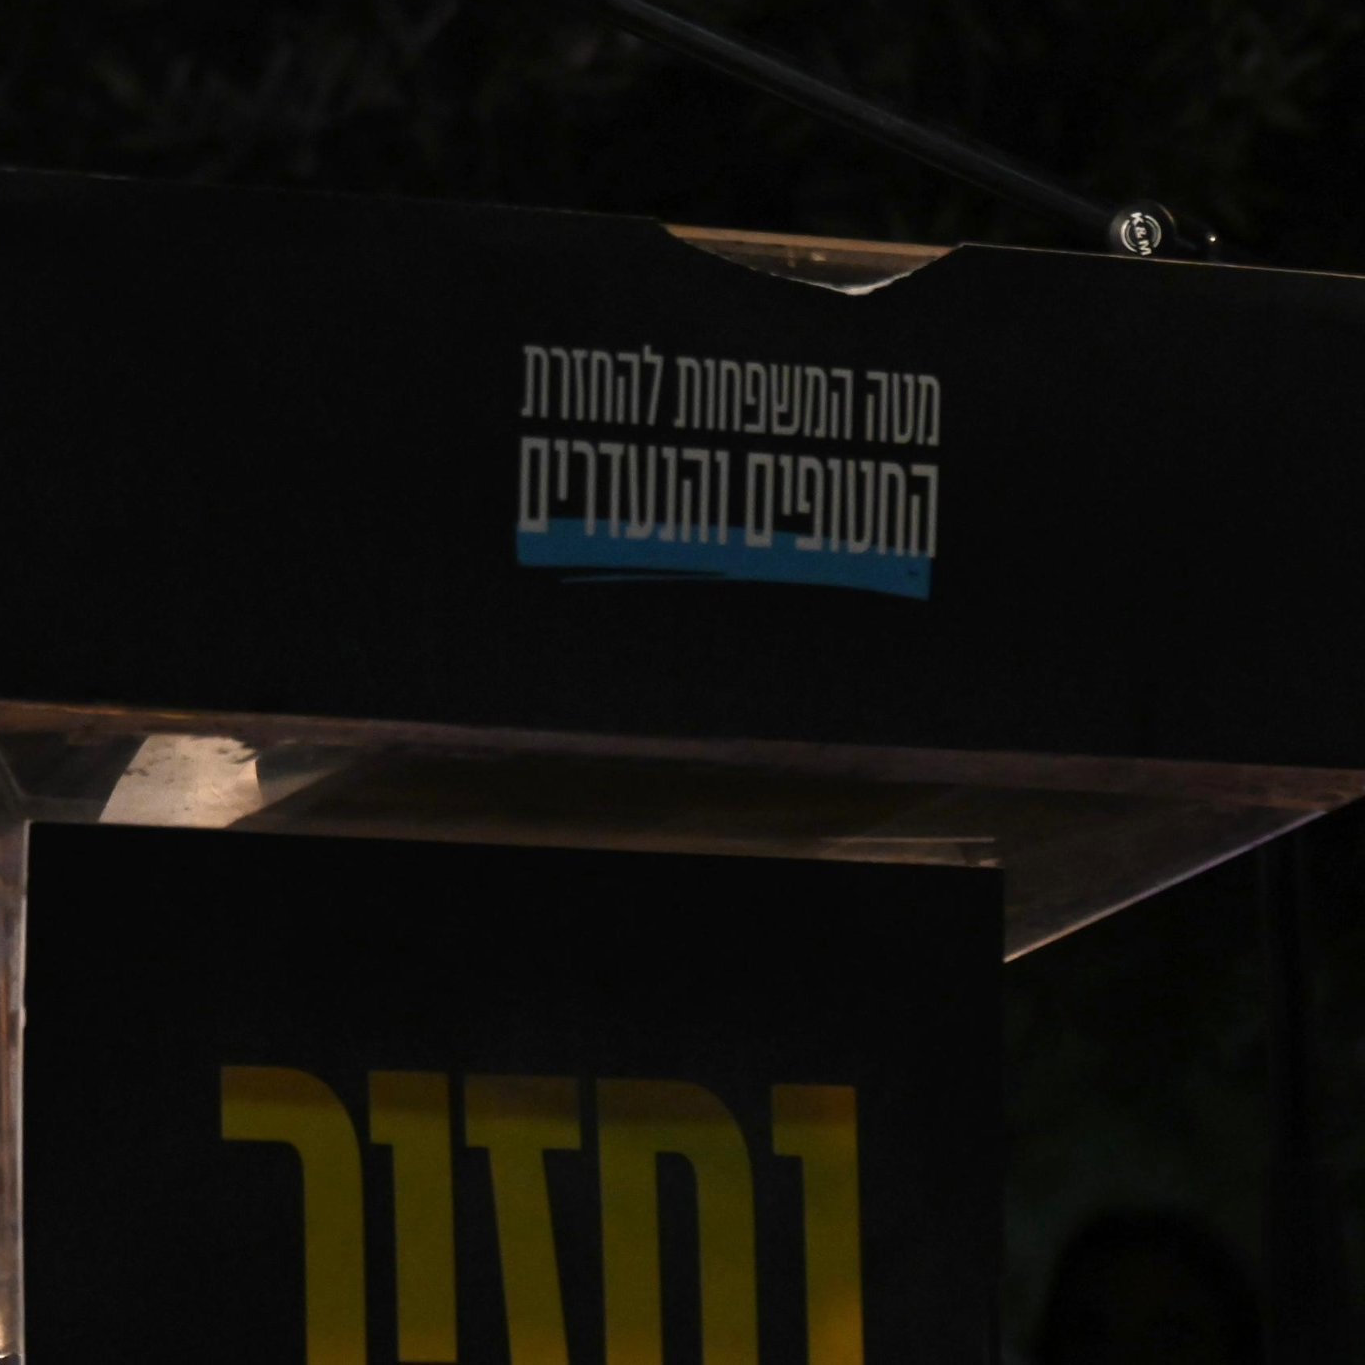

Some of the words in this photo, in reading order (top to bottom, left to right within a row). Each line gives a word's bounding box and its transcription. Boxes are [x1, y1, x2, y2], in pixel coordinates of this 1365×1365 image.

[521, 343, 664, 427] להחזרת
[673, 356, 854, 441] המשפחות
[866, 371, 941, 446] מטה
[518, 436, 730, 546] והנעדרים
[744, 451, 940, 559] החטופים
